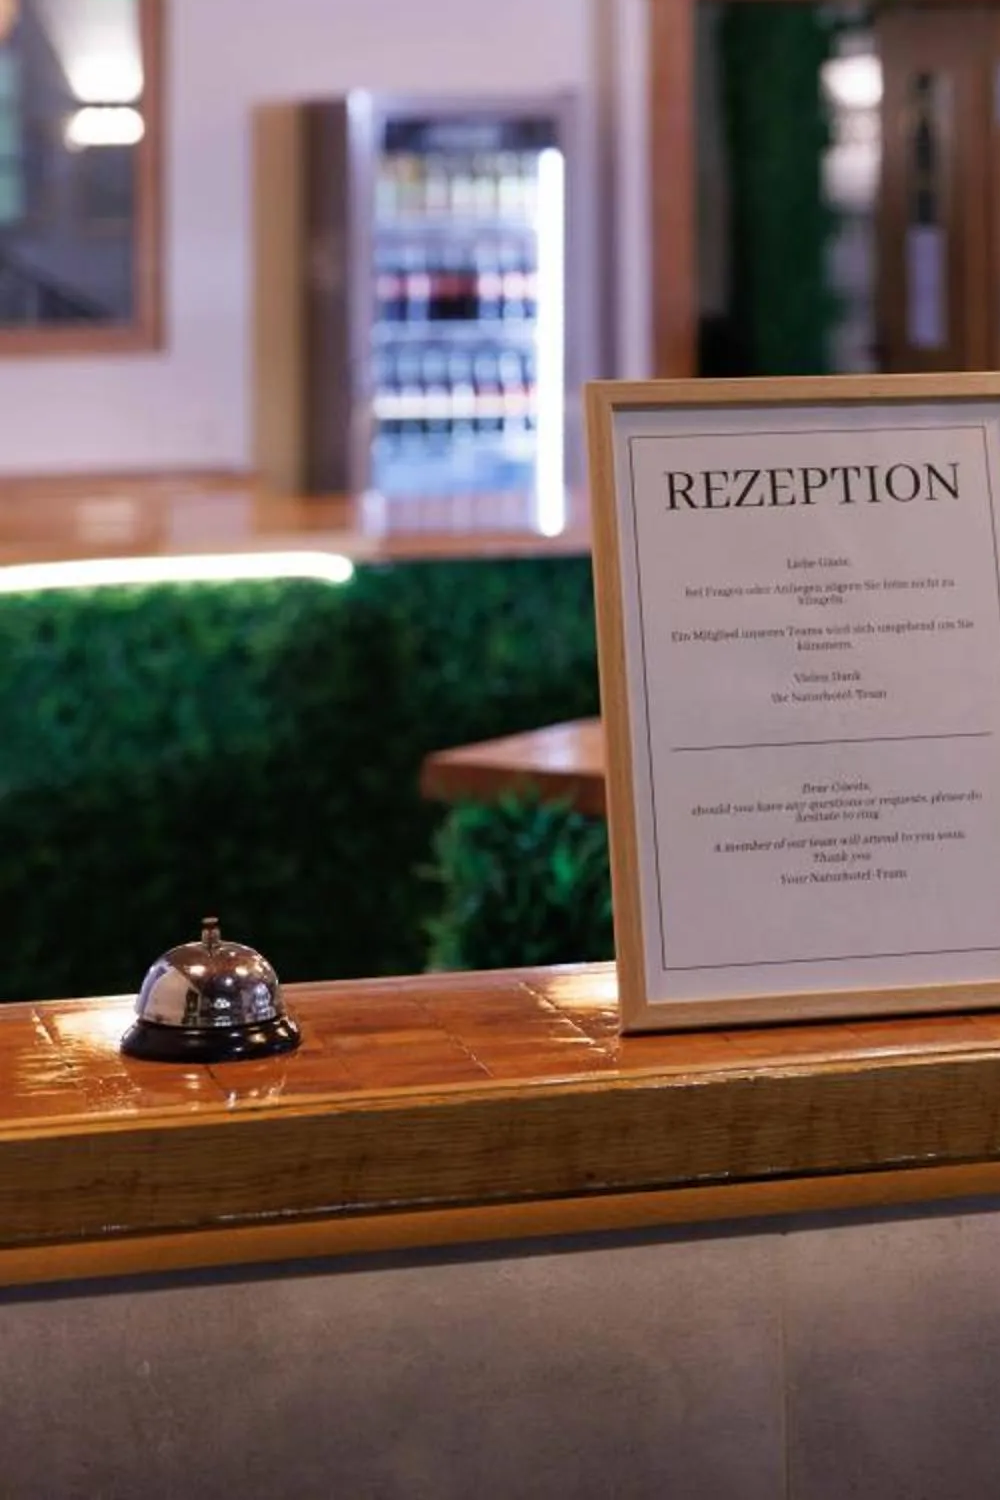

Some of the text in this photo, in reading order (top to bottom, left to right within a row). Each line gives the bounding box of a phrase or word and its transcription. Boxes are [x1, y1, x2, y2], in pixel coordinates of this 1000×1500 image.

[664, 462, 960, 511] REZEPTION
[705, 585, 743, 598] Fragen
[745, 584, 771, 595] oder
[774, 583, 823, 596] Anliegen
[864, 579, 881, 591] Sie
[883, 579, 909, 590] bitte
[911, 578, 940, 589] nicht
[941, 578, 955, 588] zu
[671, 630, 691, 643] Ein
[693, 628, 739, 642] Mitglied
[786, 626, 823, 637] Teams
[825, 624, 851, 635] wird
[853, 622, 875, 634] sich
[877, 620, 935, 634] umgehend
[937, 620, 956, 630] um
[957, 619, 974, 629] Sie
[794, 671, 861, 683] Vielen Dank
[802, 783, 829, 794] Dear
[691, 803, 731, 816] should
[733, 804, 754, 815] you
[756, 801, 783, 812] have
[785, 801, 807, 813] any
[808, 797, 862, 812] questions
[864, 797, 877, 806] or
[931, 790, 966, 805] please
[967, 789, 983, 800] do
[795, 811, 840, 823] hesitate
[842, 810, 855, 821] to
[724, 839, 773, 853] member
[773, 837, 787, 850] of
[787, 838, 807, 849] our
[809, 837, 837, 848] team
[839, 832, 861, 845] will
[862, 831, 899, 844] attend
[901, 831, 913, 842] to
[913, 831, 935, 844] you
[813, 849, 849, 863] Thank
[781, 872, 809, 886] Your
